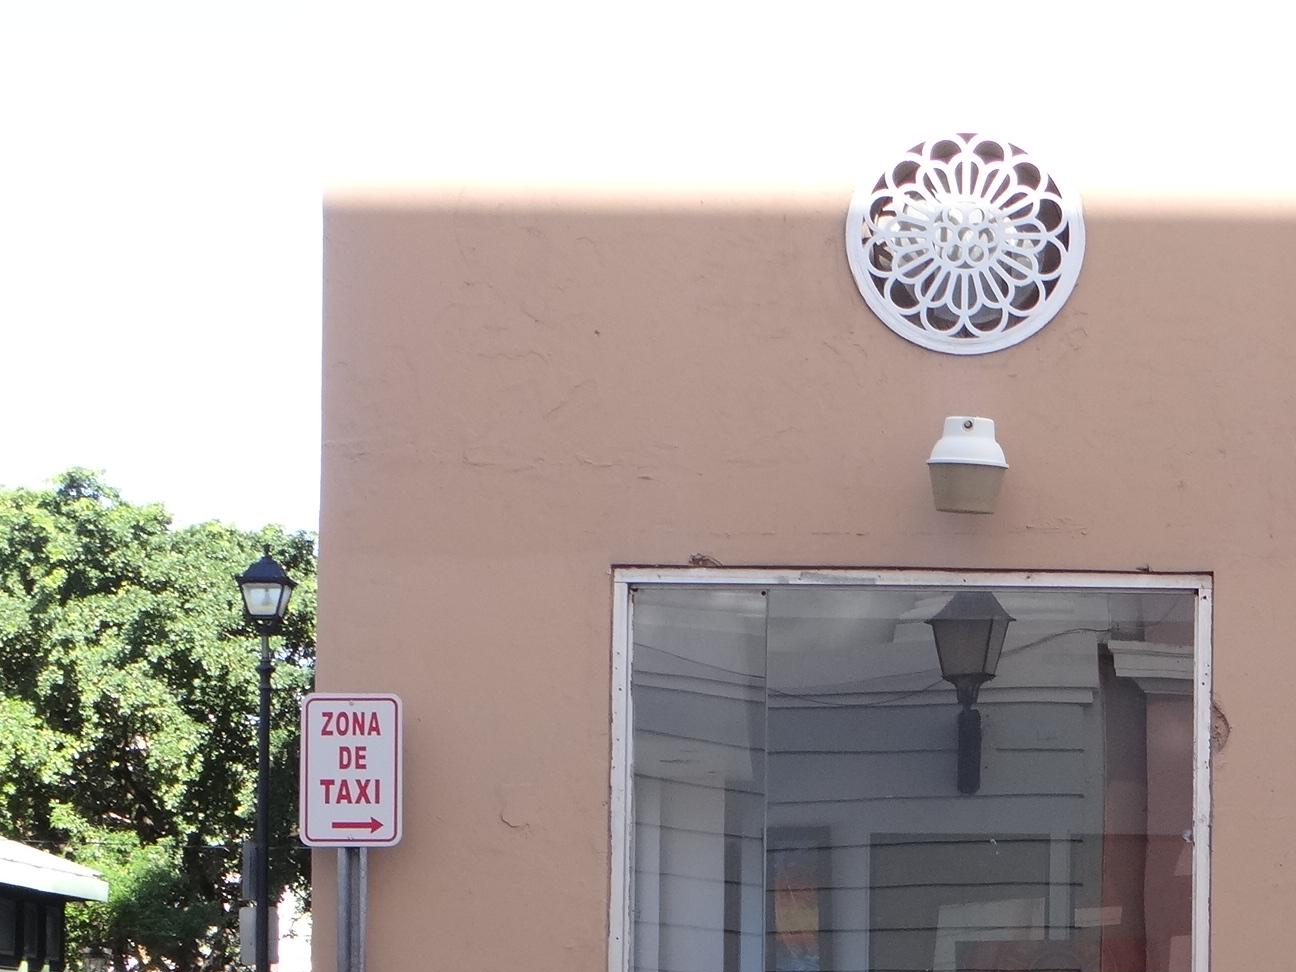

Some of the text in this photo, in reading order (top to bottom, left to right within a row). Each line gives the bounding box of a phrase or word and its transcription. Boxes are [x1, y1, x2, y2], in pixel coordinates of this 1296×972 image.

[321, 711, 381, 736] ZONA
[338, 746, 367, 769] DE
[319, 778, 380, 804] TAXI
